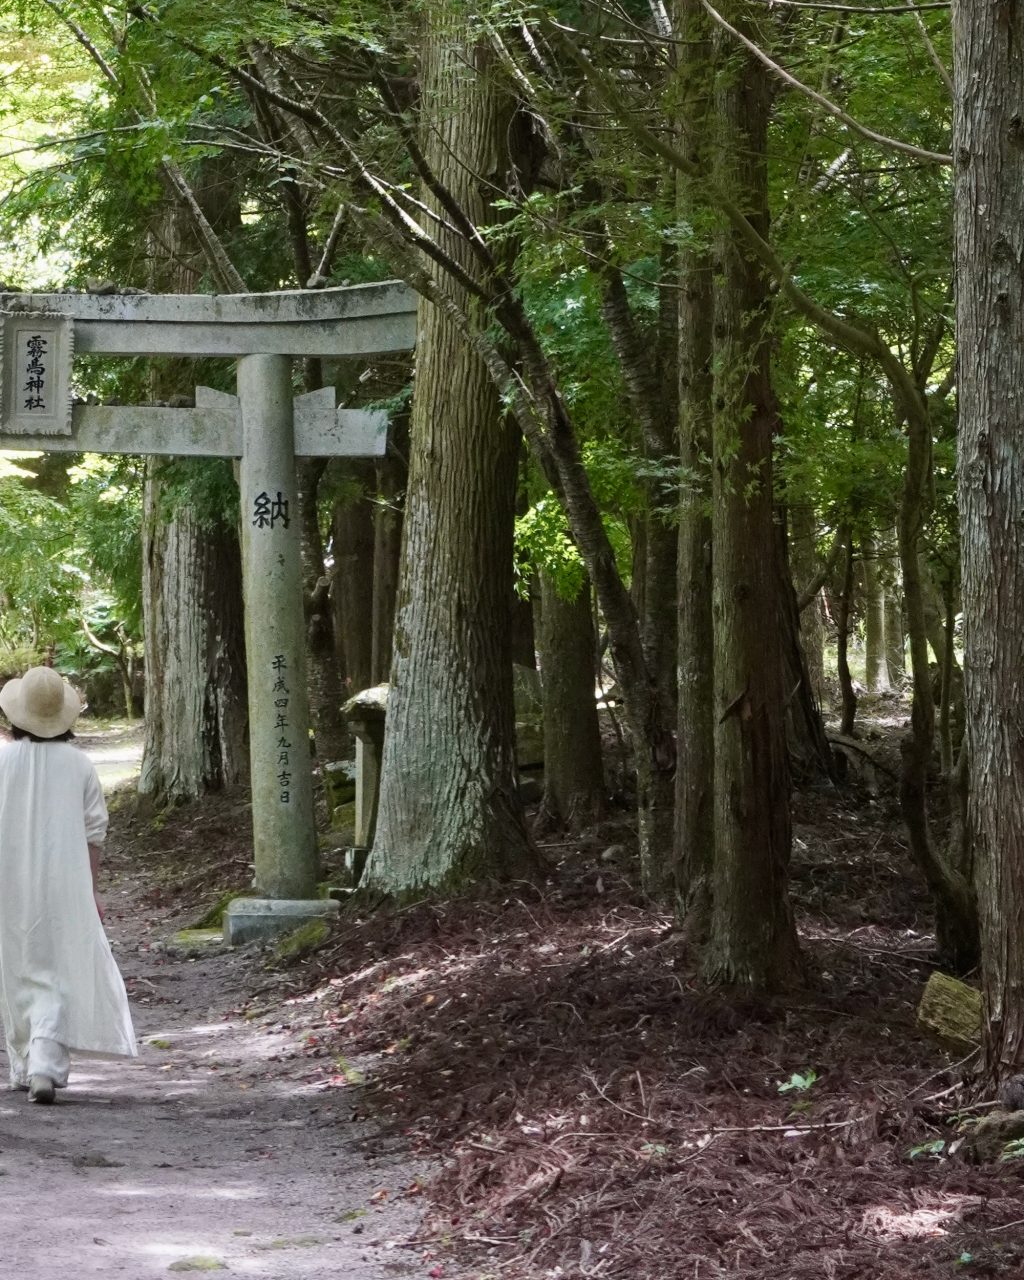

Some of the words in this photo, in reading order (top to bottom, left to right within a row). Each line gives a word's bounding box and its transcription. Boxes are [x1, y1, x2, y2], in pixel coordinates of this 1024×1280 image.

[252, 491, 291, 530] 納
[271, 654, 291, 803] 平成四年九月吉日
